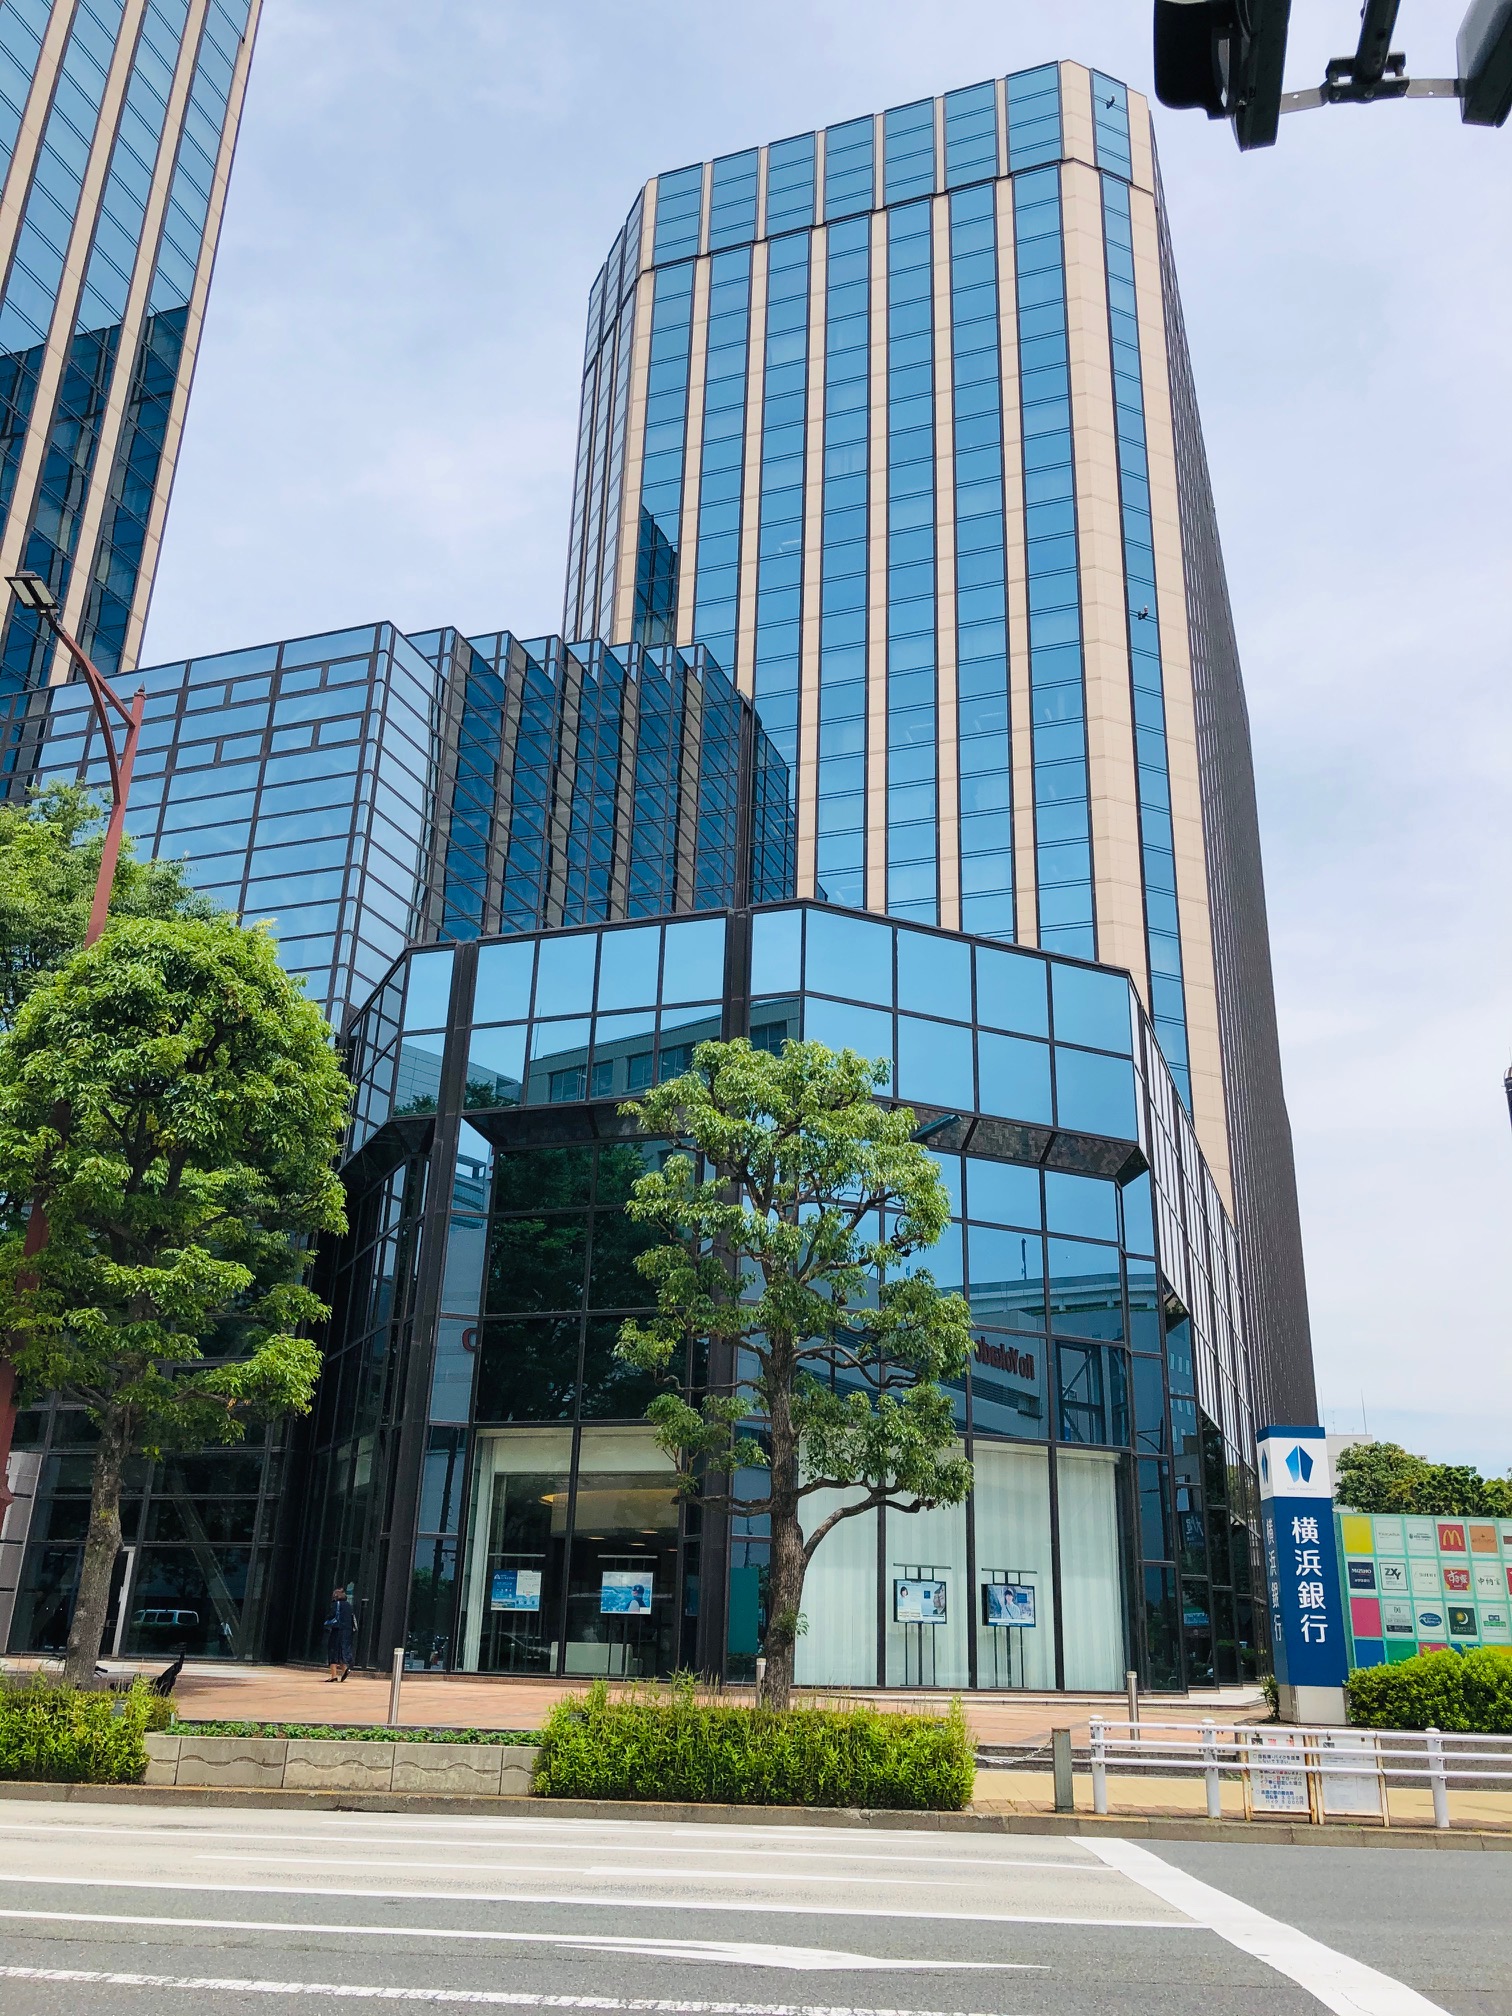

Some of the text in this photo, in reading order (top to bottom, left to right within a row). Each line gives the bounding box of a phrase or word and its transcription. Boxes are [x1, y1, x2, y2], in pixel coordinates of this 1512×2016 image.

[1265, 1517, 1282, 1642] 横浜銀行
[1291, 1516, 1328, 1643] 横浜銀行
